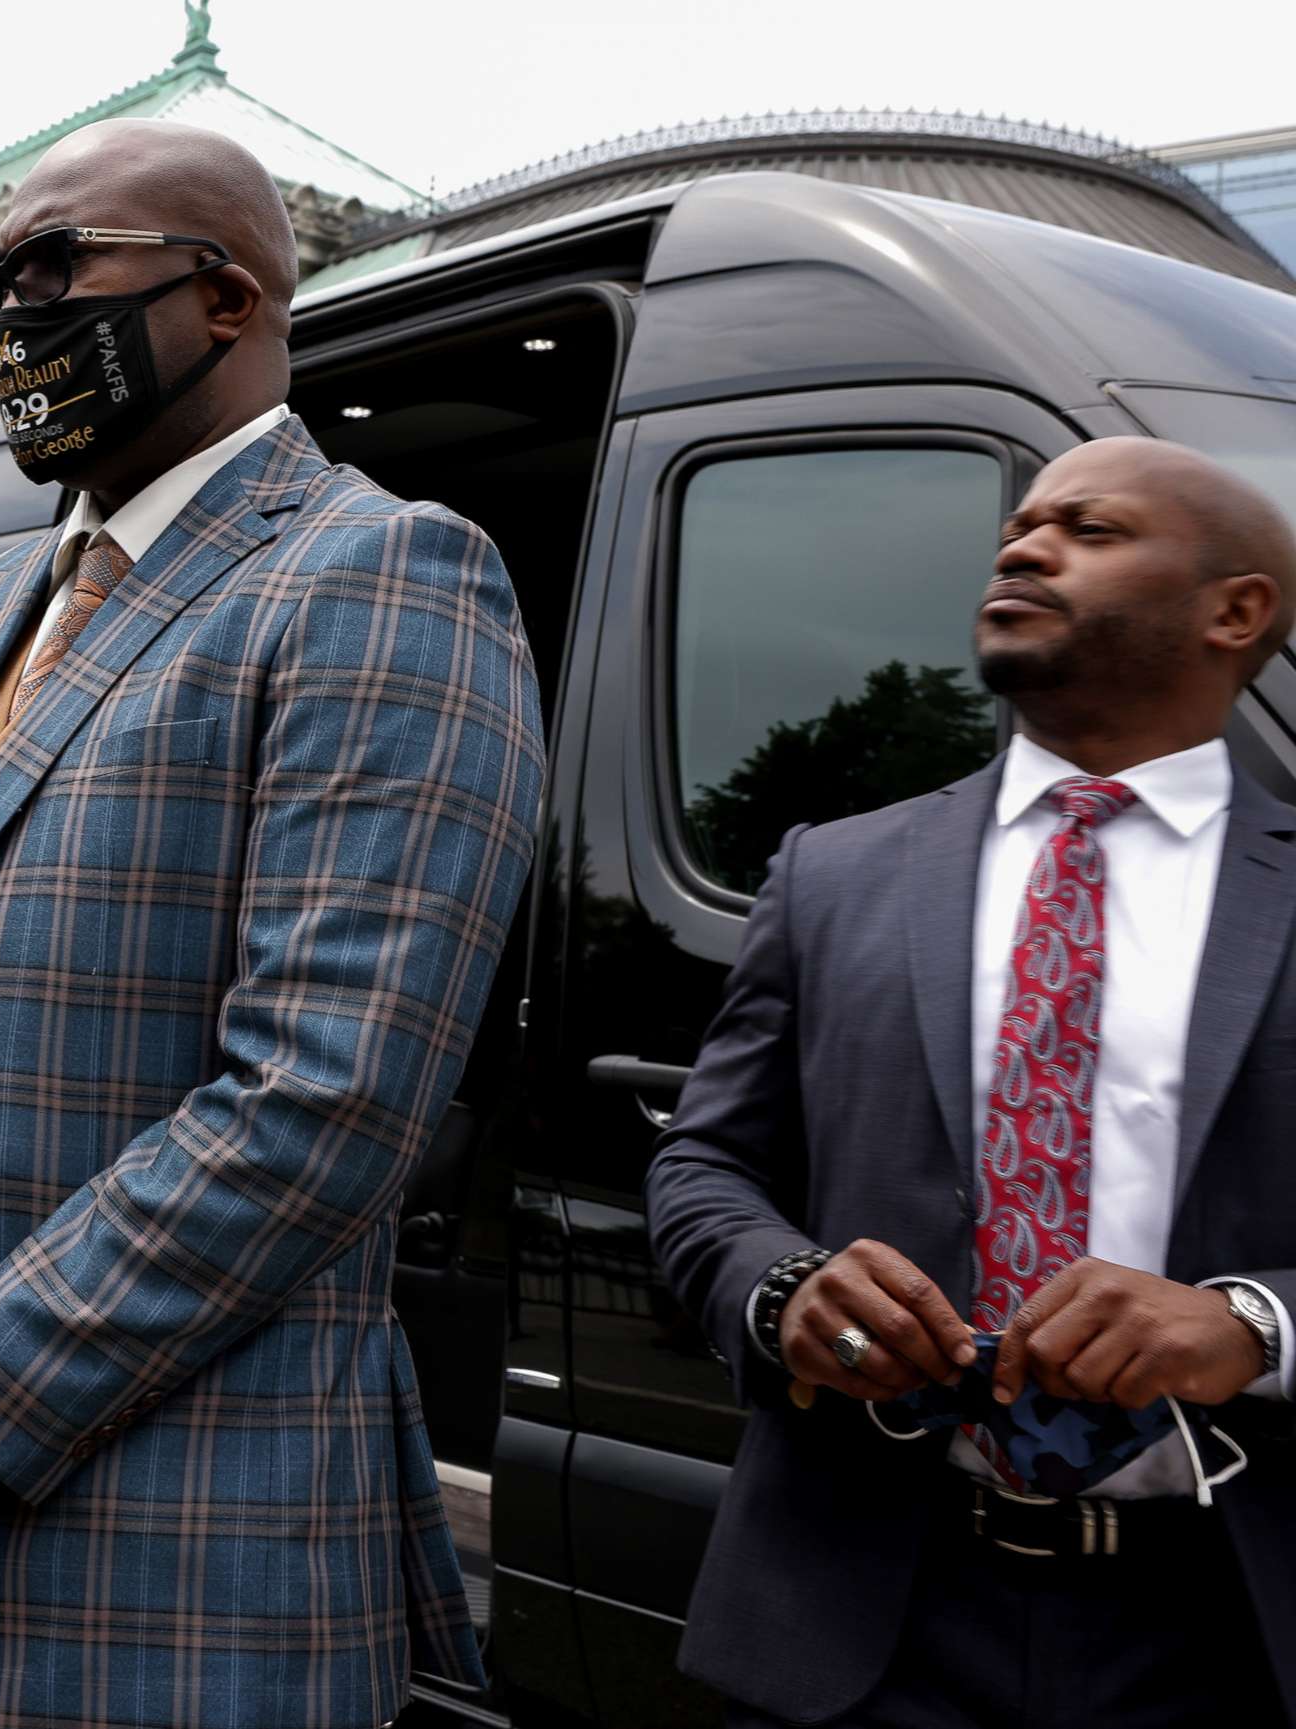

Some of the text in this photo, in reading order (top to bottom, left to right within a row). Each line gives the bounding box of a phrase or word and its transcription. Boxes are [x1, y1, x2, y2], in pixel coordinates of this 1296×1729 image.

[14, 354, 71, 392] REALITY
[95, 321, 129, 402] #PAKFIS
[19, 422, 64, 444] SECONDS
[33, 426, 96, 459] George
